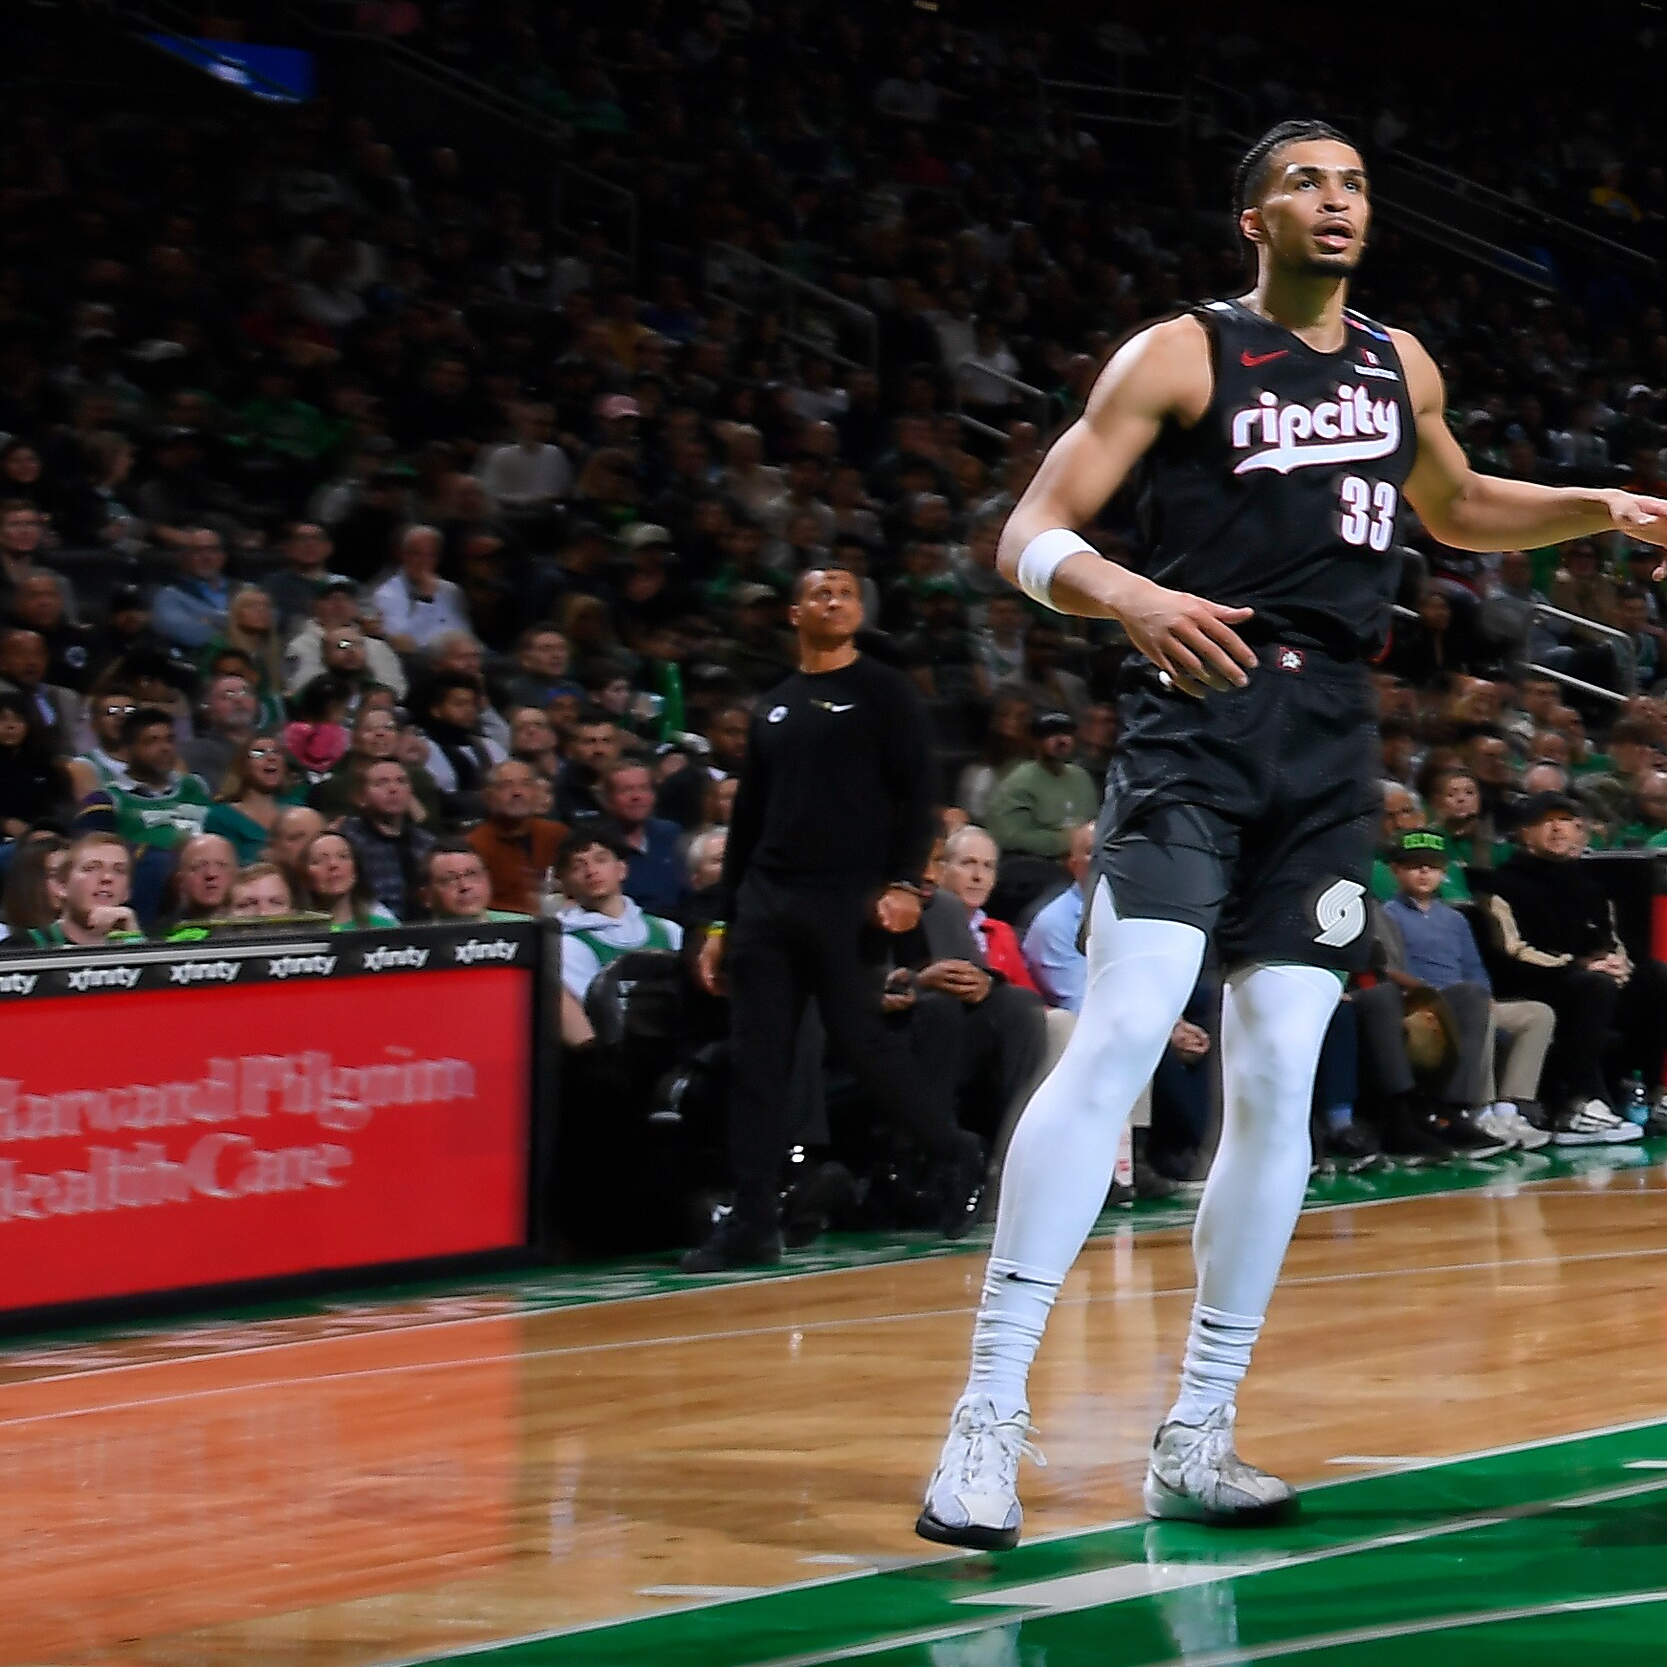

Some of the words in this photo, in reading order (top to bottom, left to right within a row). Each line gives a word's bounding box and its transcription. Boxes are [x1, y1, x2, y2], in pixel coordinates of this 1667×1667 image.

[1232, 384, 1400, 475] ripcity
[1340, 475, 1397, 552] 33
[67, 966, 142, 992] xfinity
[169, 960, 242, 985] xfinity
[267, 953, 338, 978] xfinity
[363, 945, 430, 972] xfinity
[454, 938, 520, 965] xfinity
[187, 1131, 354, 1199] Care
